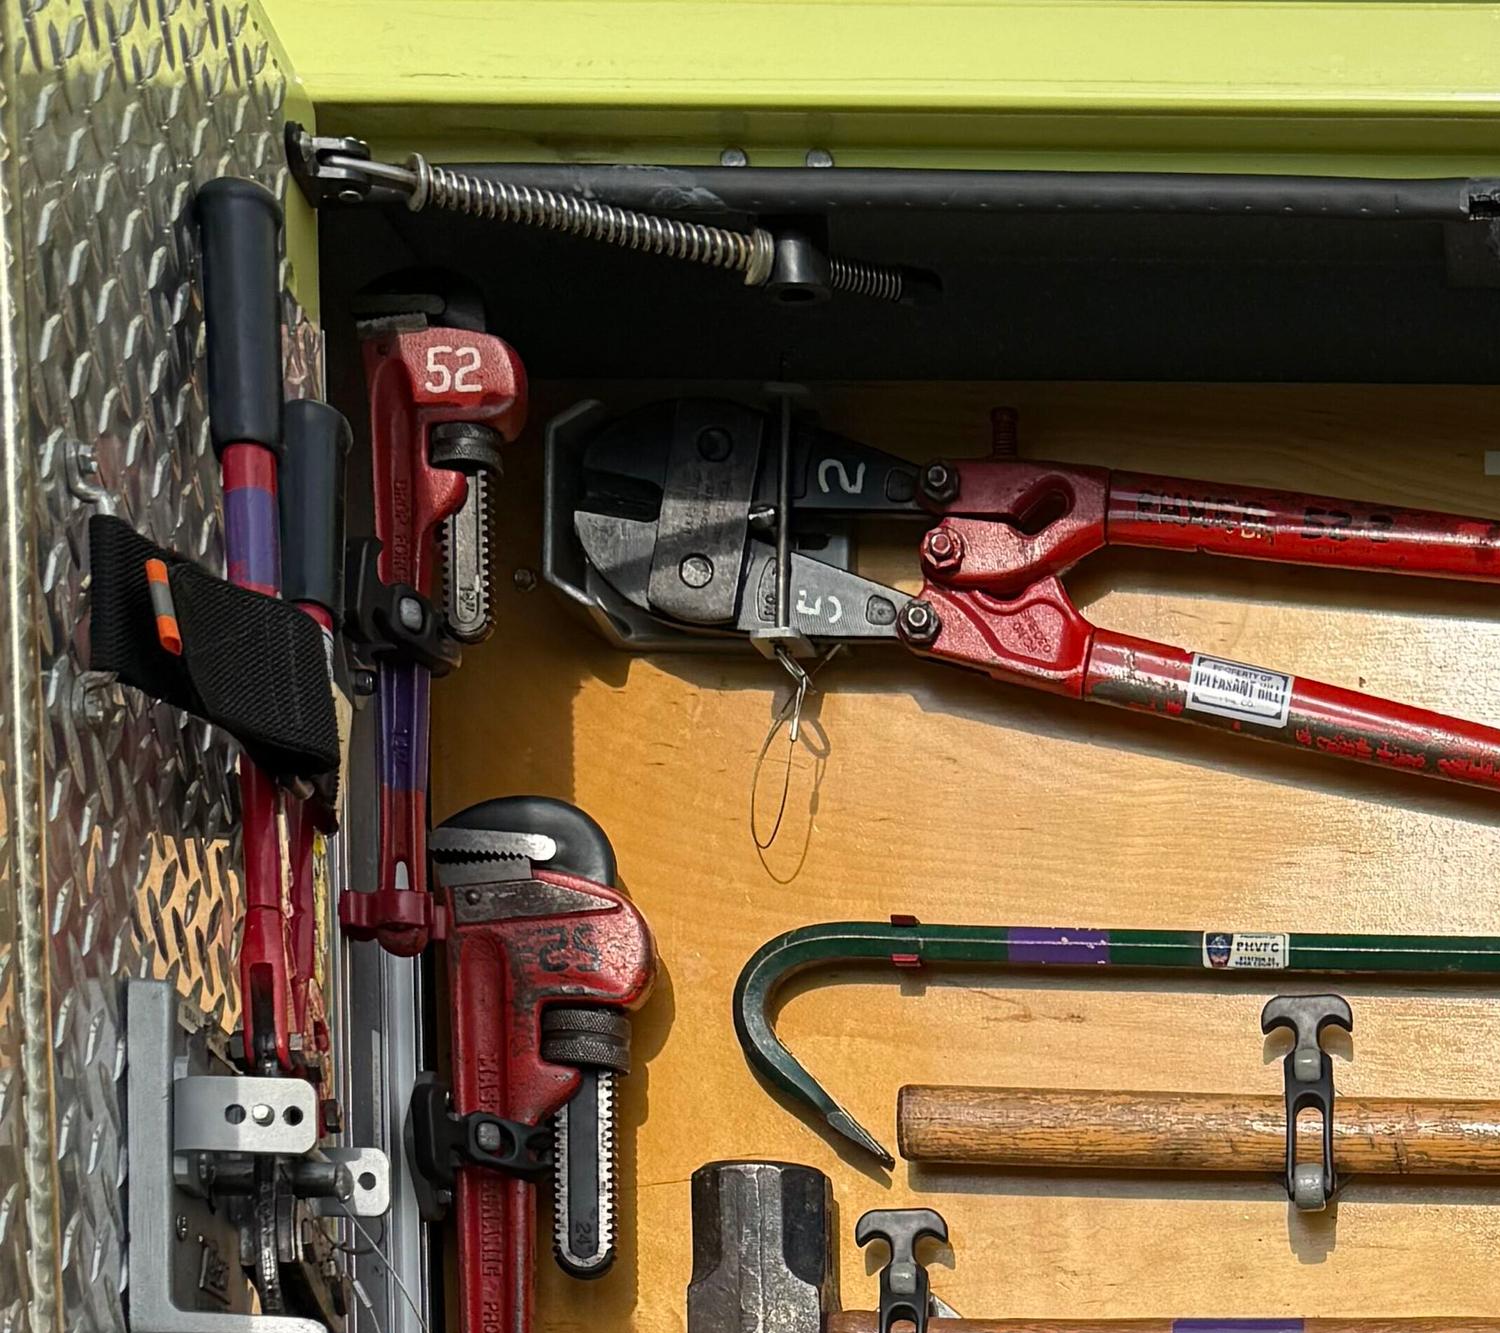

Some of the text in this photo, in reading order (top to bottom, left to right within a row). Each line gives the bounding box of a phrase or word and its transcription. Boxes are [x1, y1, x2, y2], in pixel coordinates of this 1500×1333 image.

[424, 345, 482, 394] 52
[1213, 663, 1260, 680] PROPERTY
[1199, 672, 1255, 698] PLEASANT
